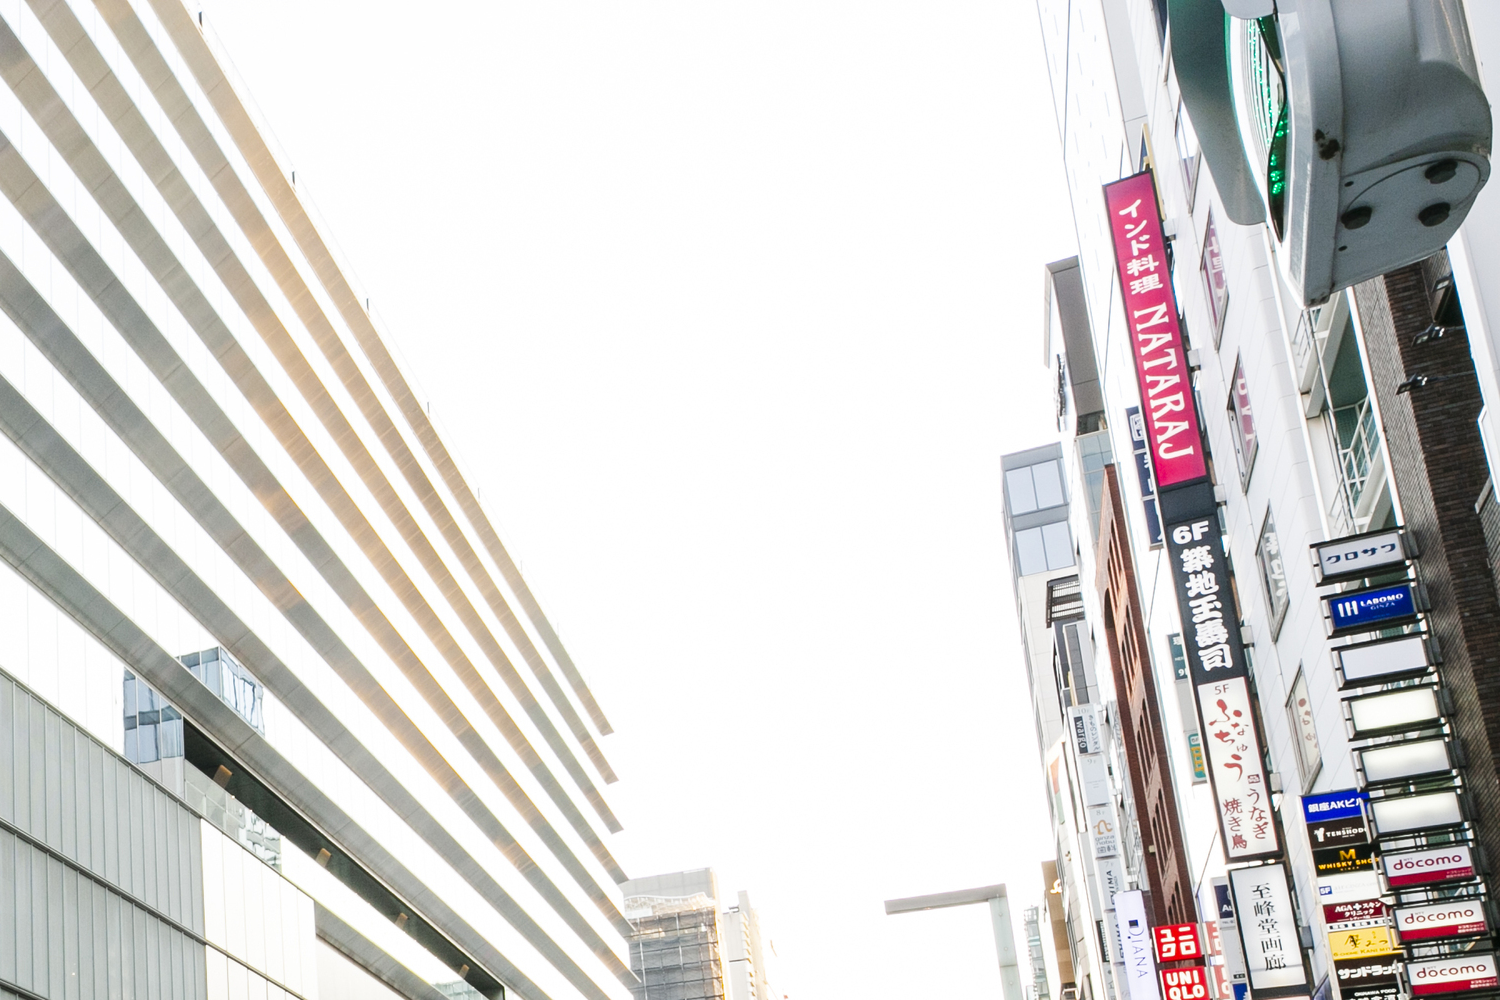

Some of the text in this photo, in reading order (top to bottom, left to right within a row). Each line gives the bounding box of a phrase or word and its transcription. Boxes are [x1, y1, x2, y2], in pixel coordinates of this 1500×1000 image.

[1118, 198, 1164, 295] インド料理
[1133, 301, 1195, 461] NATARAJ
[1172, 520, 1209, 545] 6F
[1360, 593, 1404, 607] LABOMO
[1370, 602, 1396, 611] GINZA
[1214, 684, 1230, 695] 5F
[1246, 788, 1269, 840] うなぎ
[1223, 797, 1247, 850] 焼き鳥
[1339, 848, 1356, 861] M
[1393, 854, 1462, 870] docomo
[1318, 861, 1352, 870] WHISKY
[1335, 901, 1383, 912] AGA スキン
[1344, 909, 1375, 918] クリニック
[1404, 909, 1474, 924] docomo
[1250, 882, 1287, 971] 至峰堂画廊
[1160, 926, 1195, 944] ユニ
[1127, 919, 1149, 979] DIANA
[1162, 941, 1197, 958] クロ
[1166, 968, 1202, 987] UNI
[1416, 964, 1487, 979] docomo
